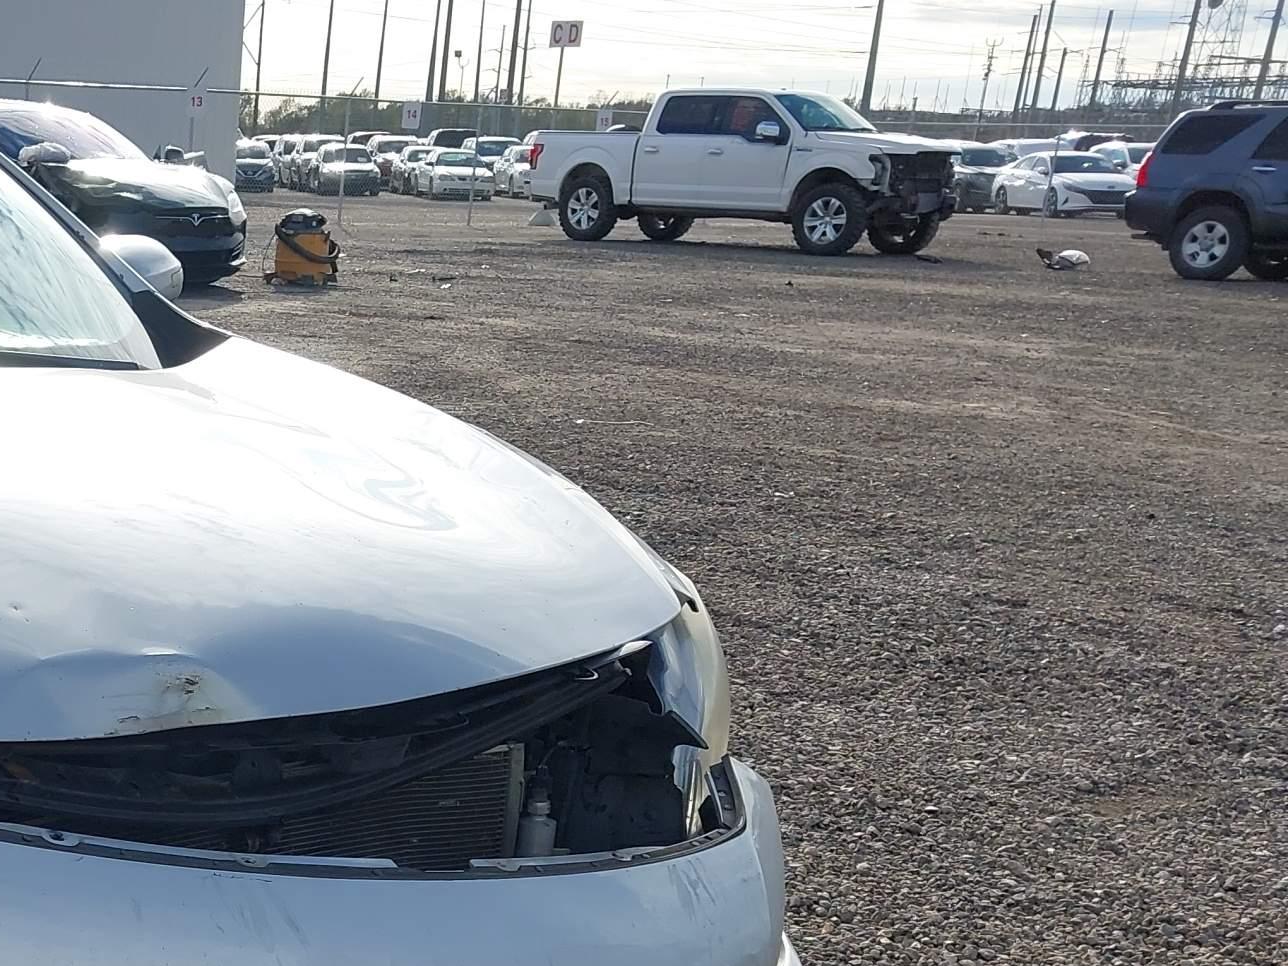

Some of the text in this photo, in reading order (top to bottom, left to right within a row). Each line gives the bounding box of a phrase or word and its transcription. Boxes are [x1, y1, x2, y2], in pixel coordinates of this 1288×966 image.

[553, 23, 579, 44] C D
[192, 96, 203, 107] 13
[407, 110, 417, 119] 14
